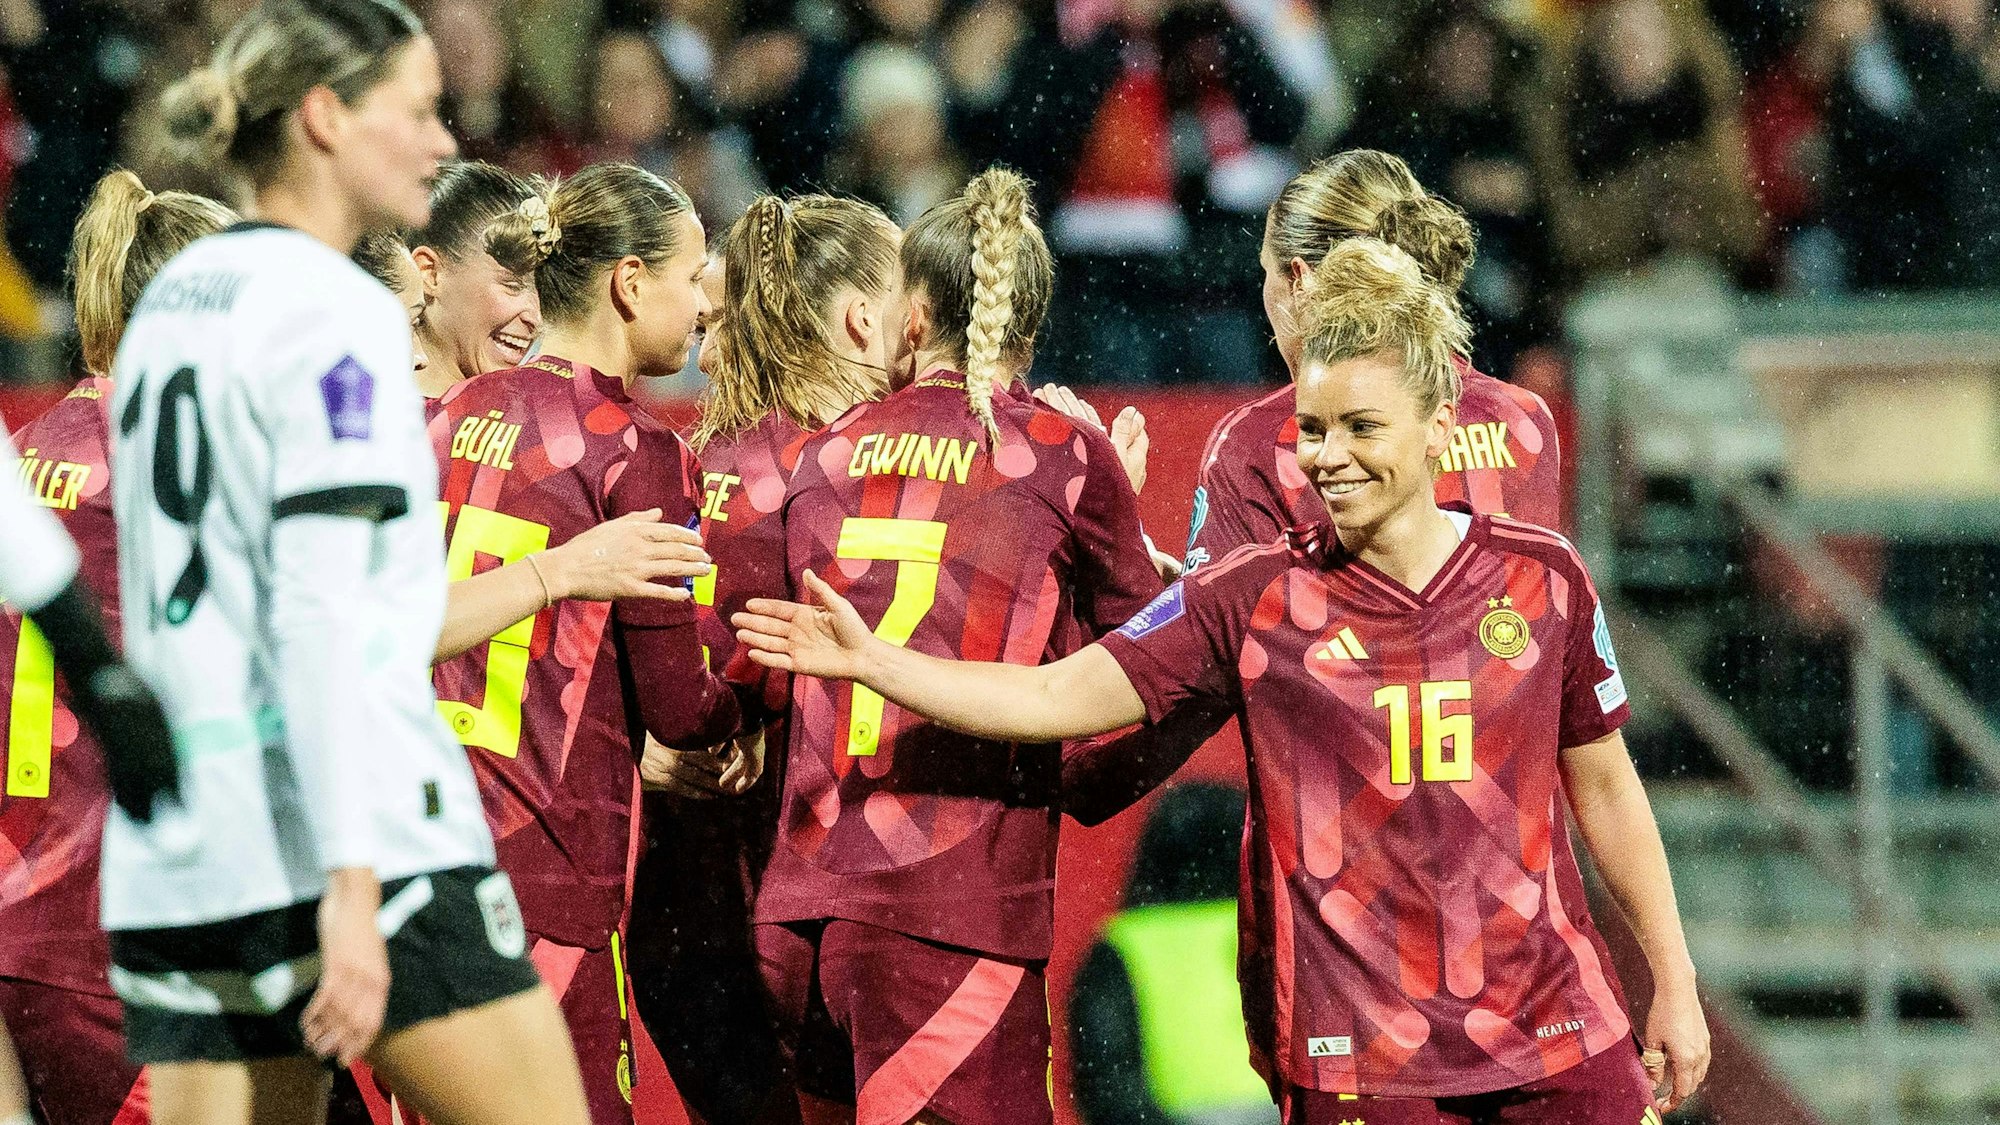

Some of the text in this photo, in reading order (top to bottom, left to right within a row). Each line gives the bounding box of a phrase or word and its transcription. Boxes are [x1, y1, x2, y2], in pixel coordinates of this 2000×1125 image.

[450, 409, 523, 471] BÜHL
[848, 432, 978, 485] GWINN
[700, 471, 742, 522] GE
[837, 517, 949, 757] 7
[1372, 680, 1475, 785] 16
[1536, 1019, 1586, 1039] HEAT.RDY
